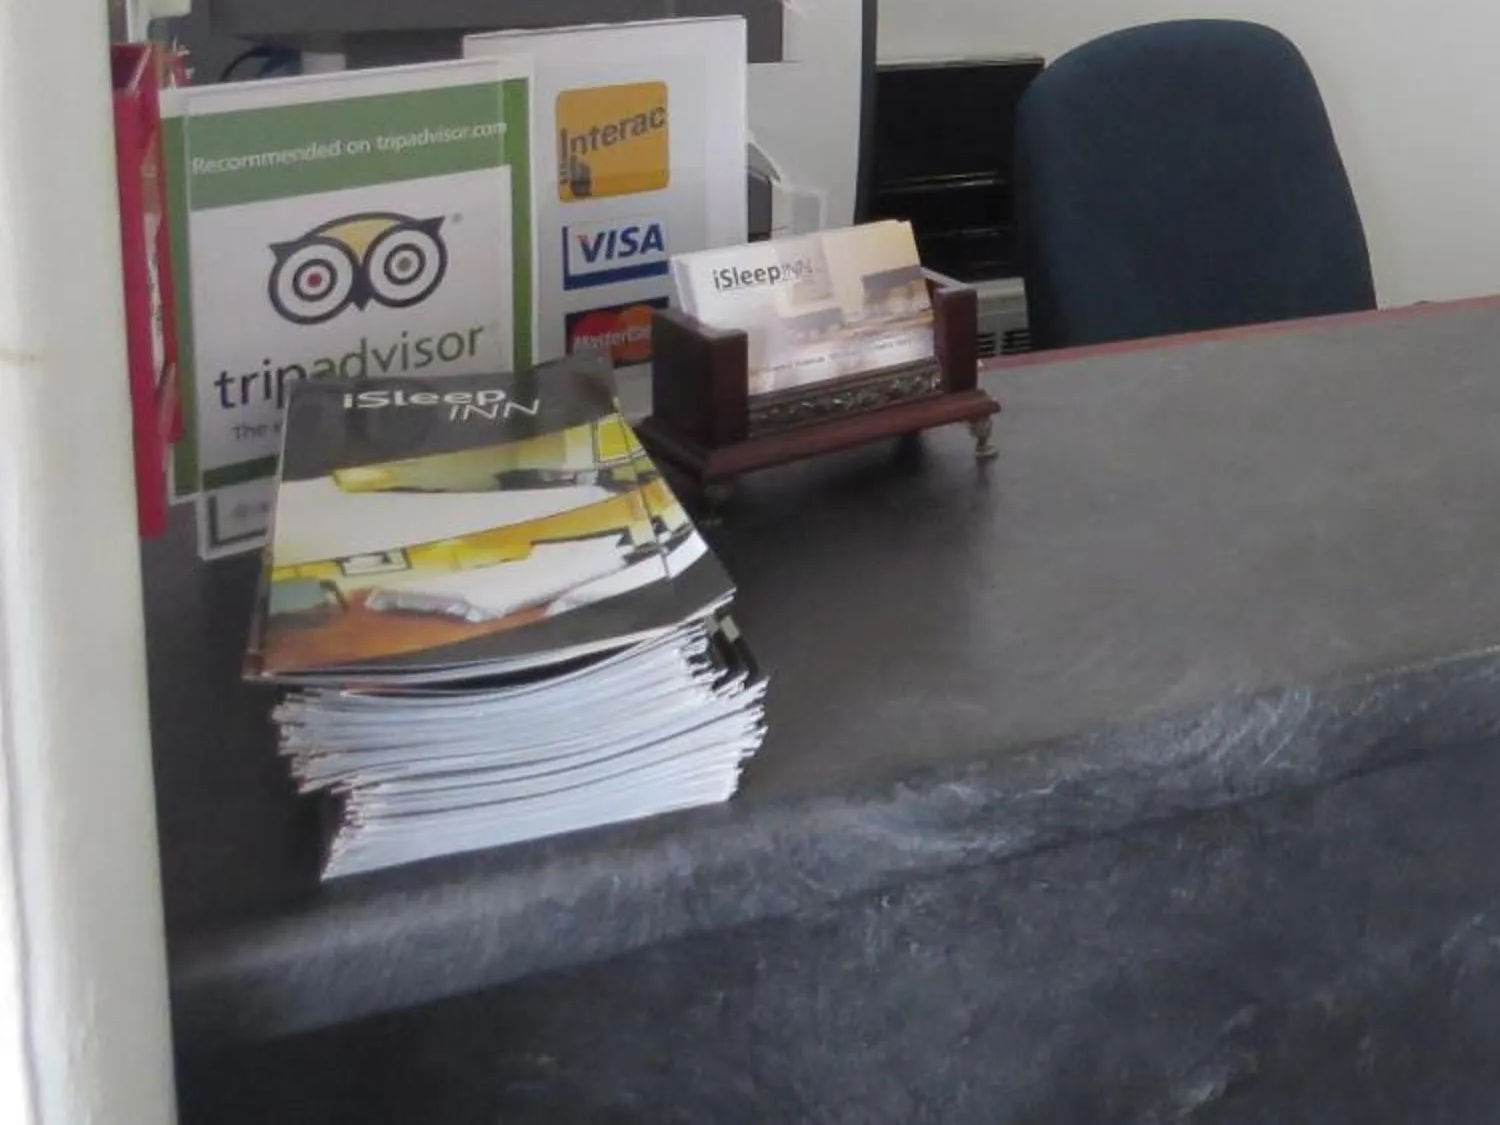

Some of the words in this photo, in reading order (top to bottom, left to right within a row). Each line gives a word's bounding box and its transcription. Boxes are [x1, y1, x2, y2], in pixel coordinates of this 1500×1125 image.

[192, 139, 342, 174] Recommended
[346, 139, 371, 155] on
[376, 122, 508, 152] tripadvisor.com
[560, 106, 665, 163] Interac
[577, 223, 665, 264] VISA
[342, 388, 506, 410] iSleep
[450, 399, 540, 423] INN
